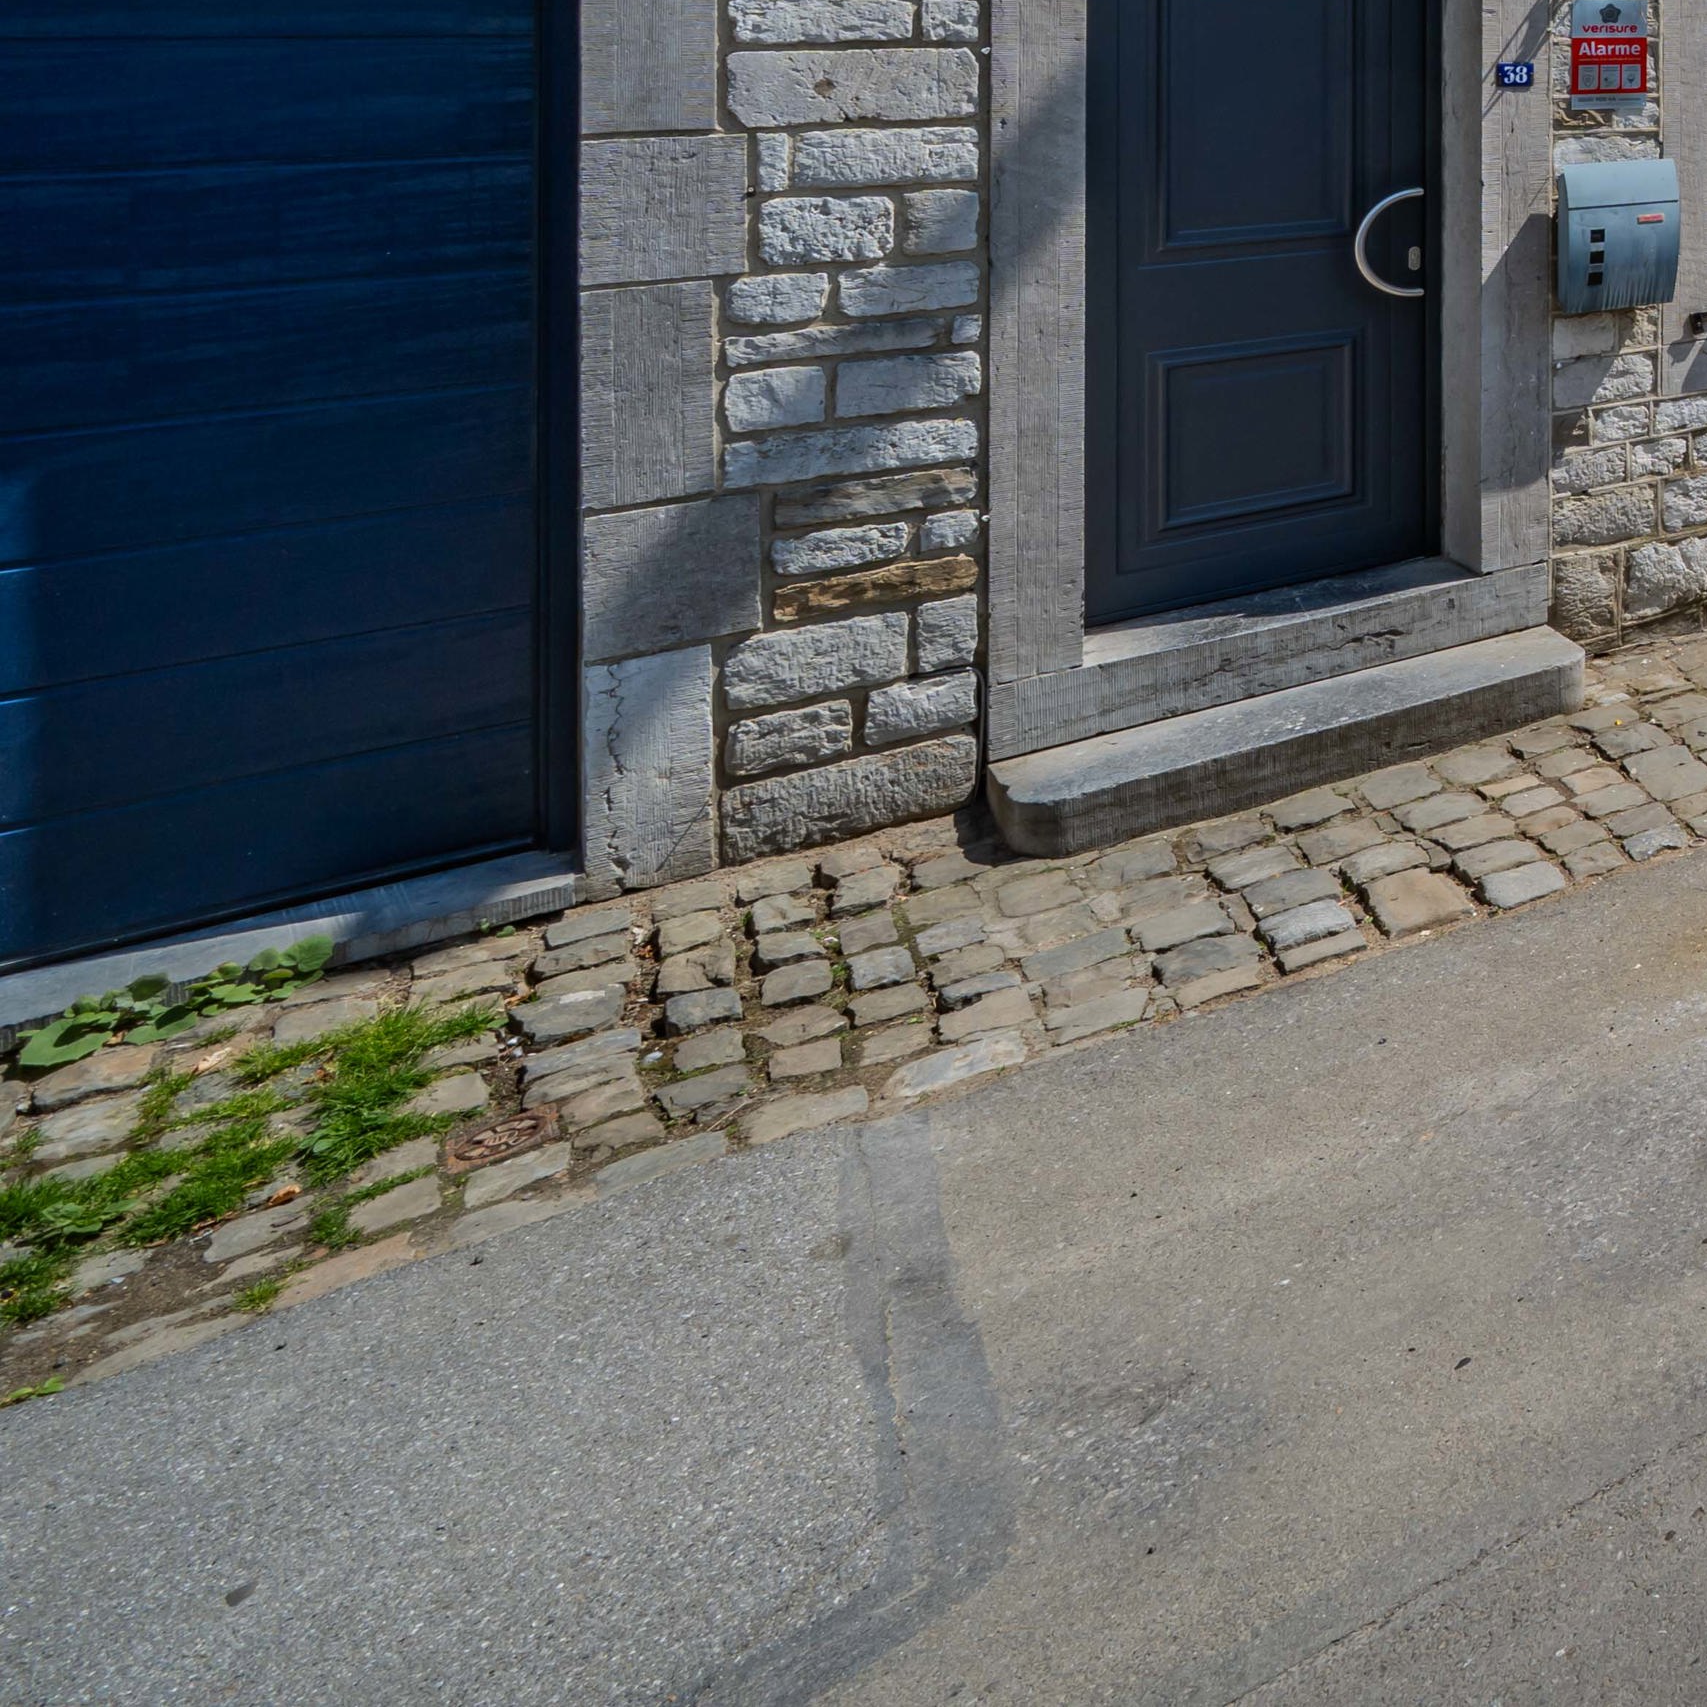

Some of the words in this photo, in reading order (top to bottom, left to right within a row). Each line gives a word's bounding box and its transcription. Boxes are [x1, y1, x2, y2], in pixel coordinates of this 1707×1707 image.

[1582, 24, 1638, 34] verisure
[1578, 40, 1641, 56] Alarme
[1503, 65, 1528, 84] 38
